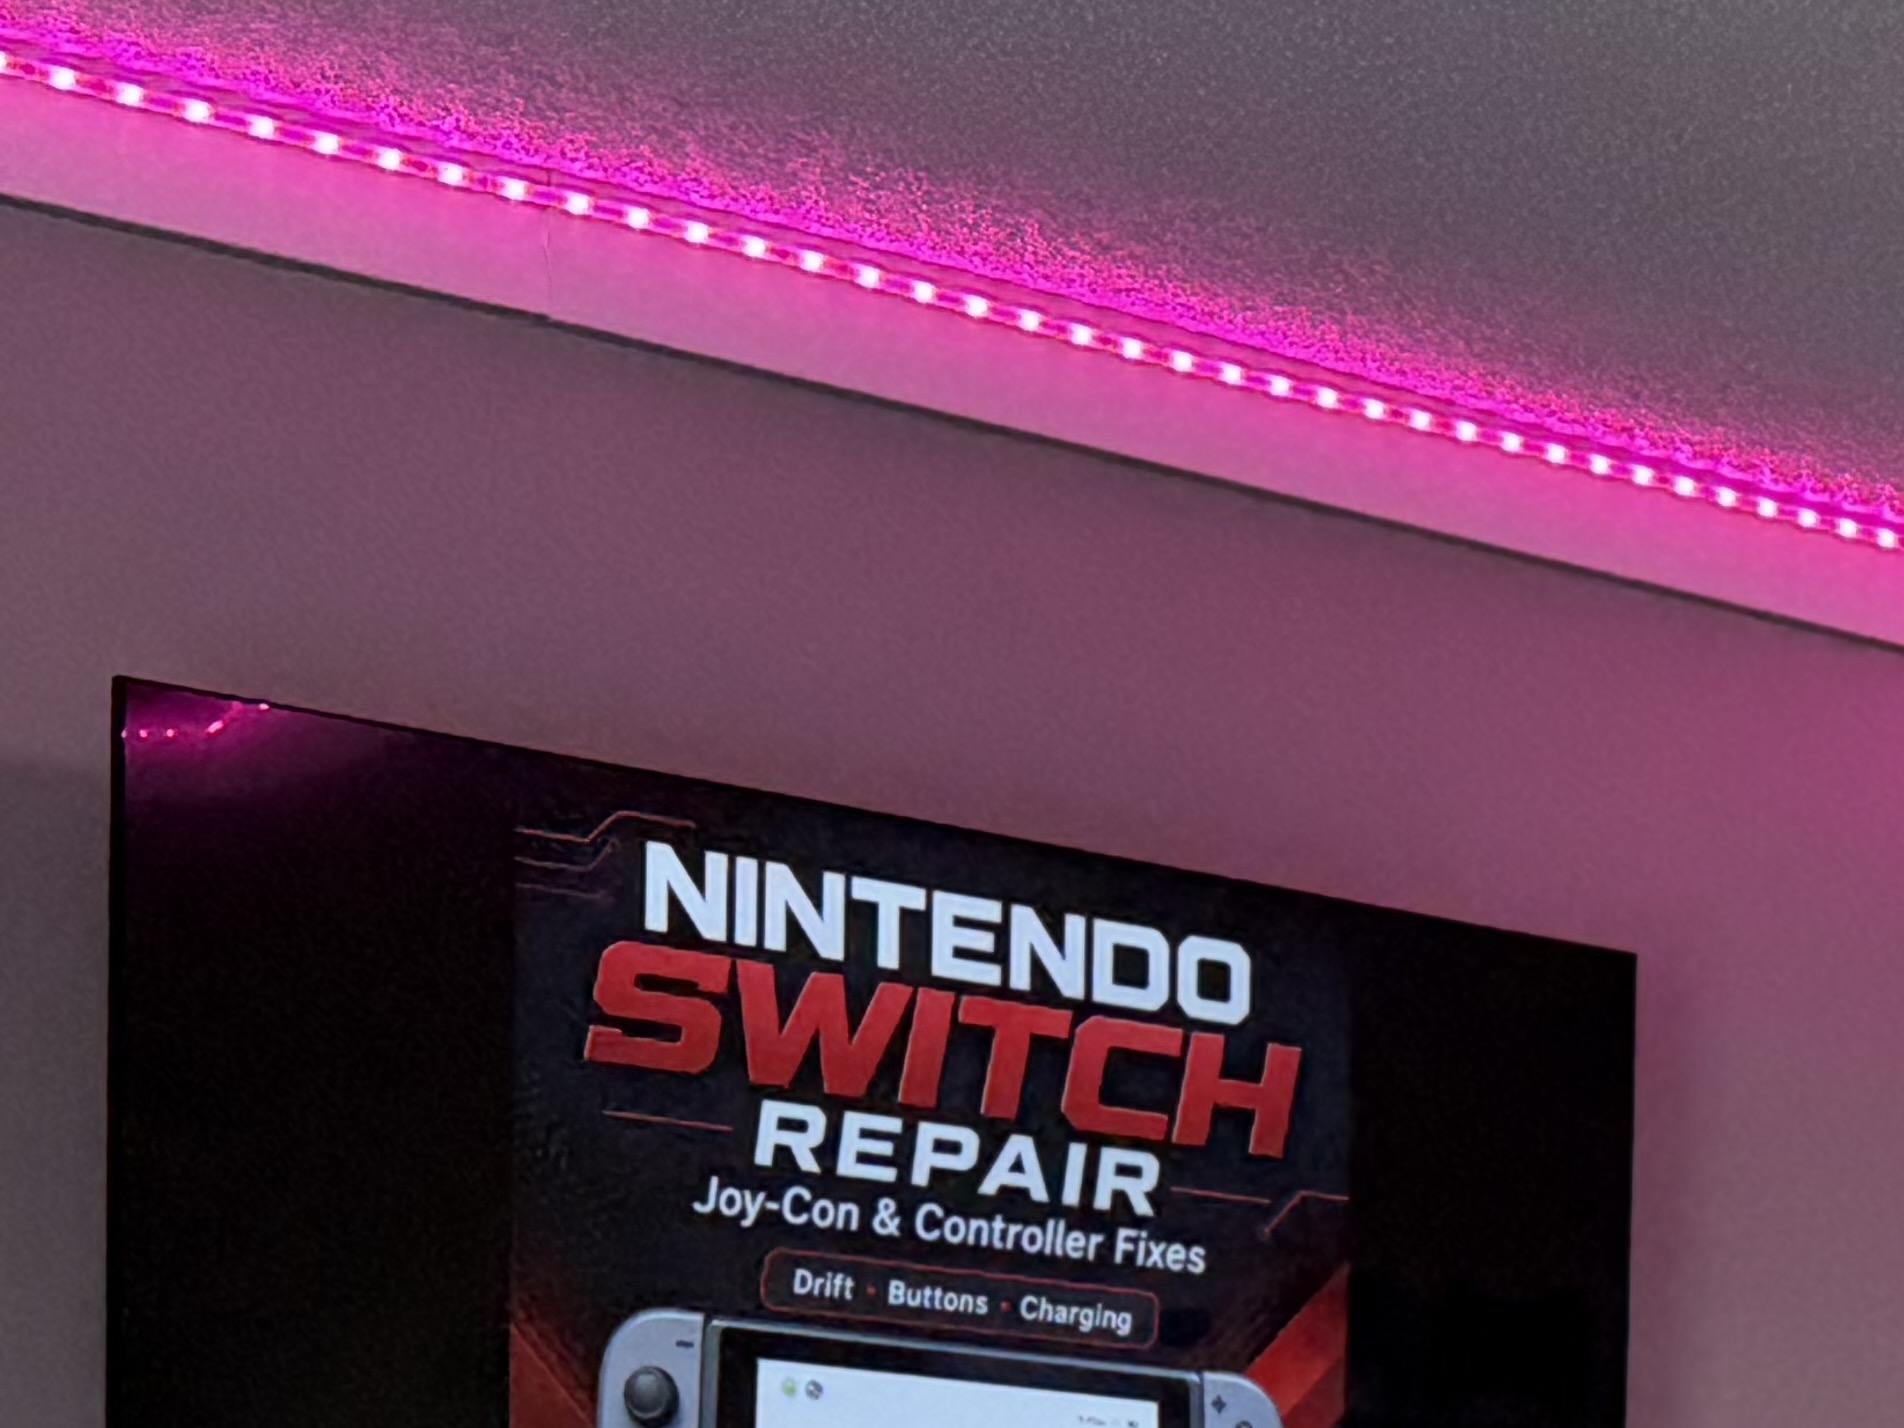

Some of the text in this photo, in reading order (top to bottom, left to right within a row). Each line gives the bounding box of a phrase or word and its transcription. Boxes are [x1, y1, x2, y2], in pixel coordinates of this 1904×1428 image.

[644, 841, 1252, 1024] NINTENDO
[583, 940, 1301, 1157] SWITCH
[753, 1100, 1160, 1216] REPAIR
[692, 1176, 1206, 1275] Joy-Con & Controller Fixes
[793, 1269, 1133, 1336] Drift Buttons Charging
